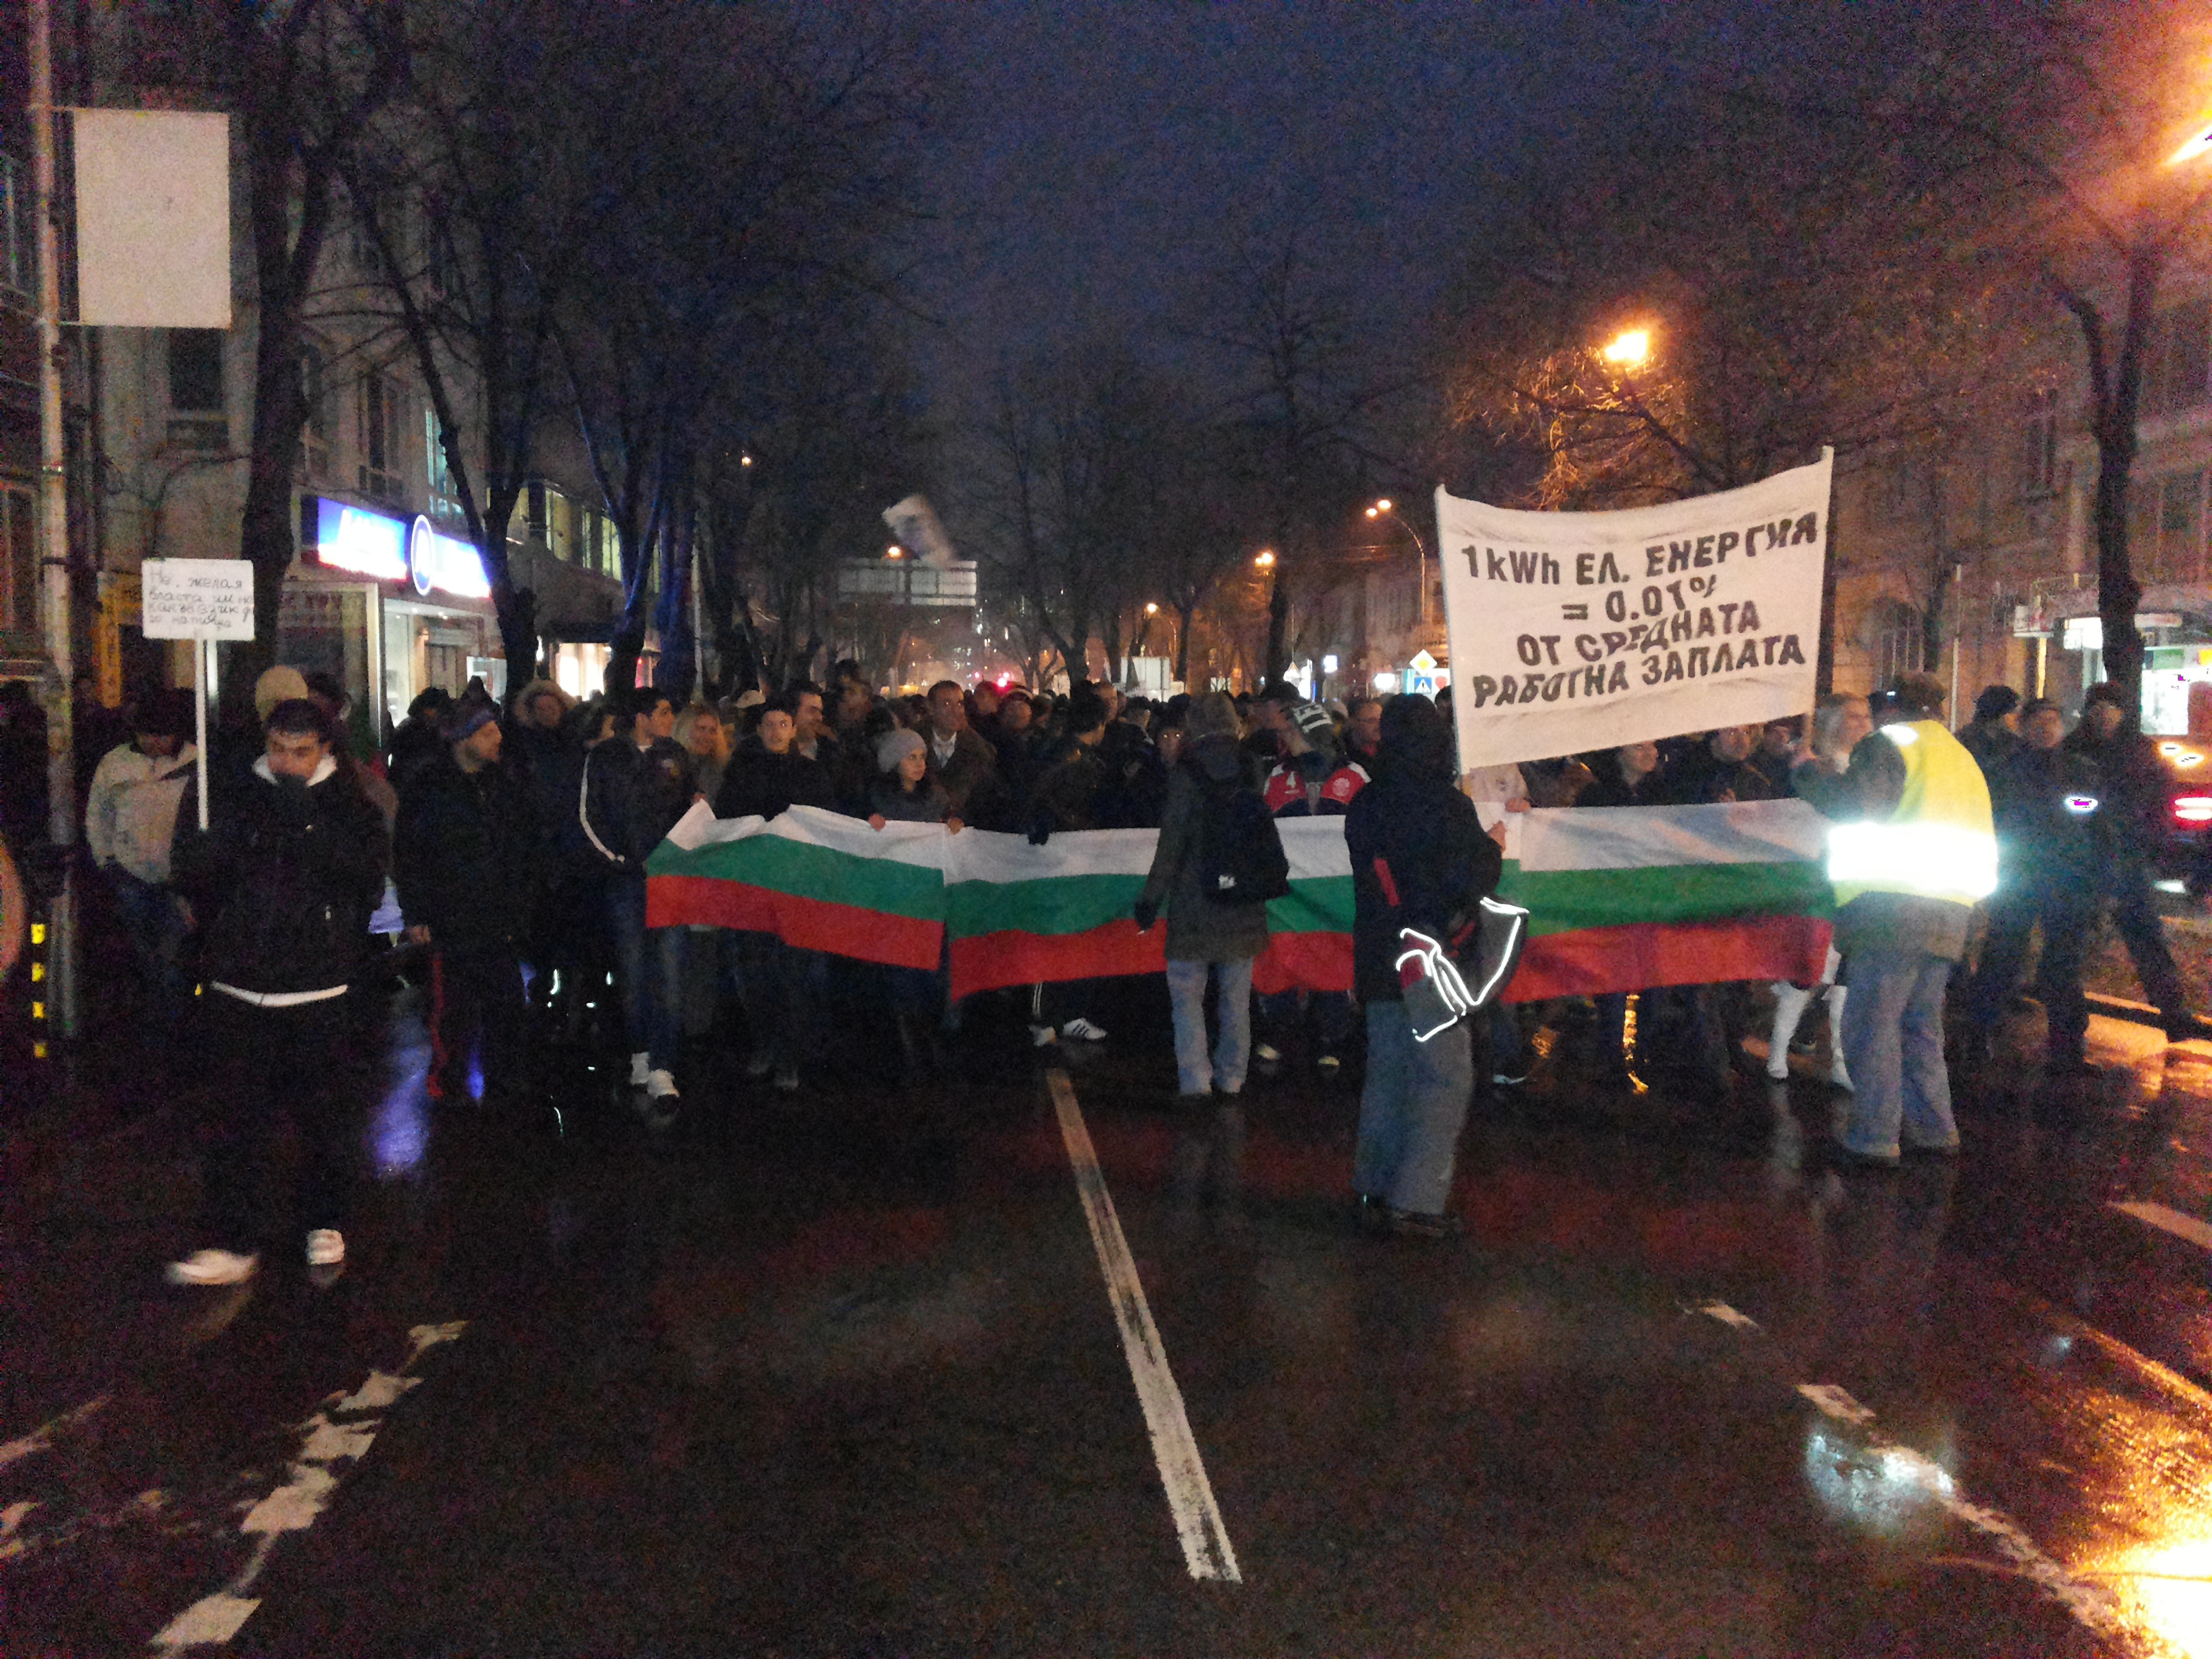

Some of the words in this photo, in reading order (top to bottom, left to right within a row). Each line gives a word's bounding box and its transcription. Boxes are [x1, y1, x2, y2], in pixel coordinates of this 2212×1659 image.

[1576, 552, 1630, 585] ЕЛ.
[1645, 512, 1818, 577] ЕНЕРГИЯ
[1517, 634, 1561, 666] ОТ
[1574, 600, 1761, 662] СРЕДНАТА
[1561, 603, 1589, 620] =
[1473, 661, 1629, 708] РАБОТНА
[1641, 634, 1806, 685] ЗАПЛАТА
